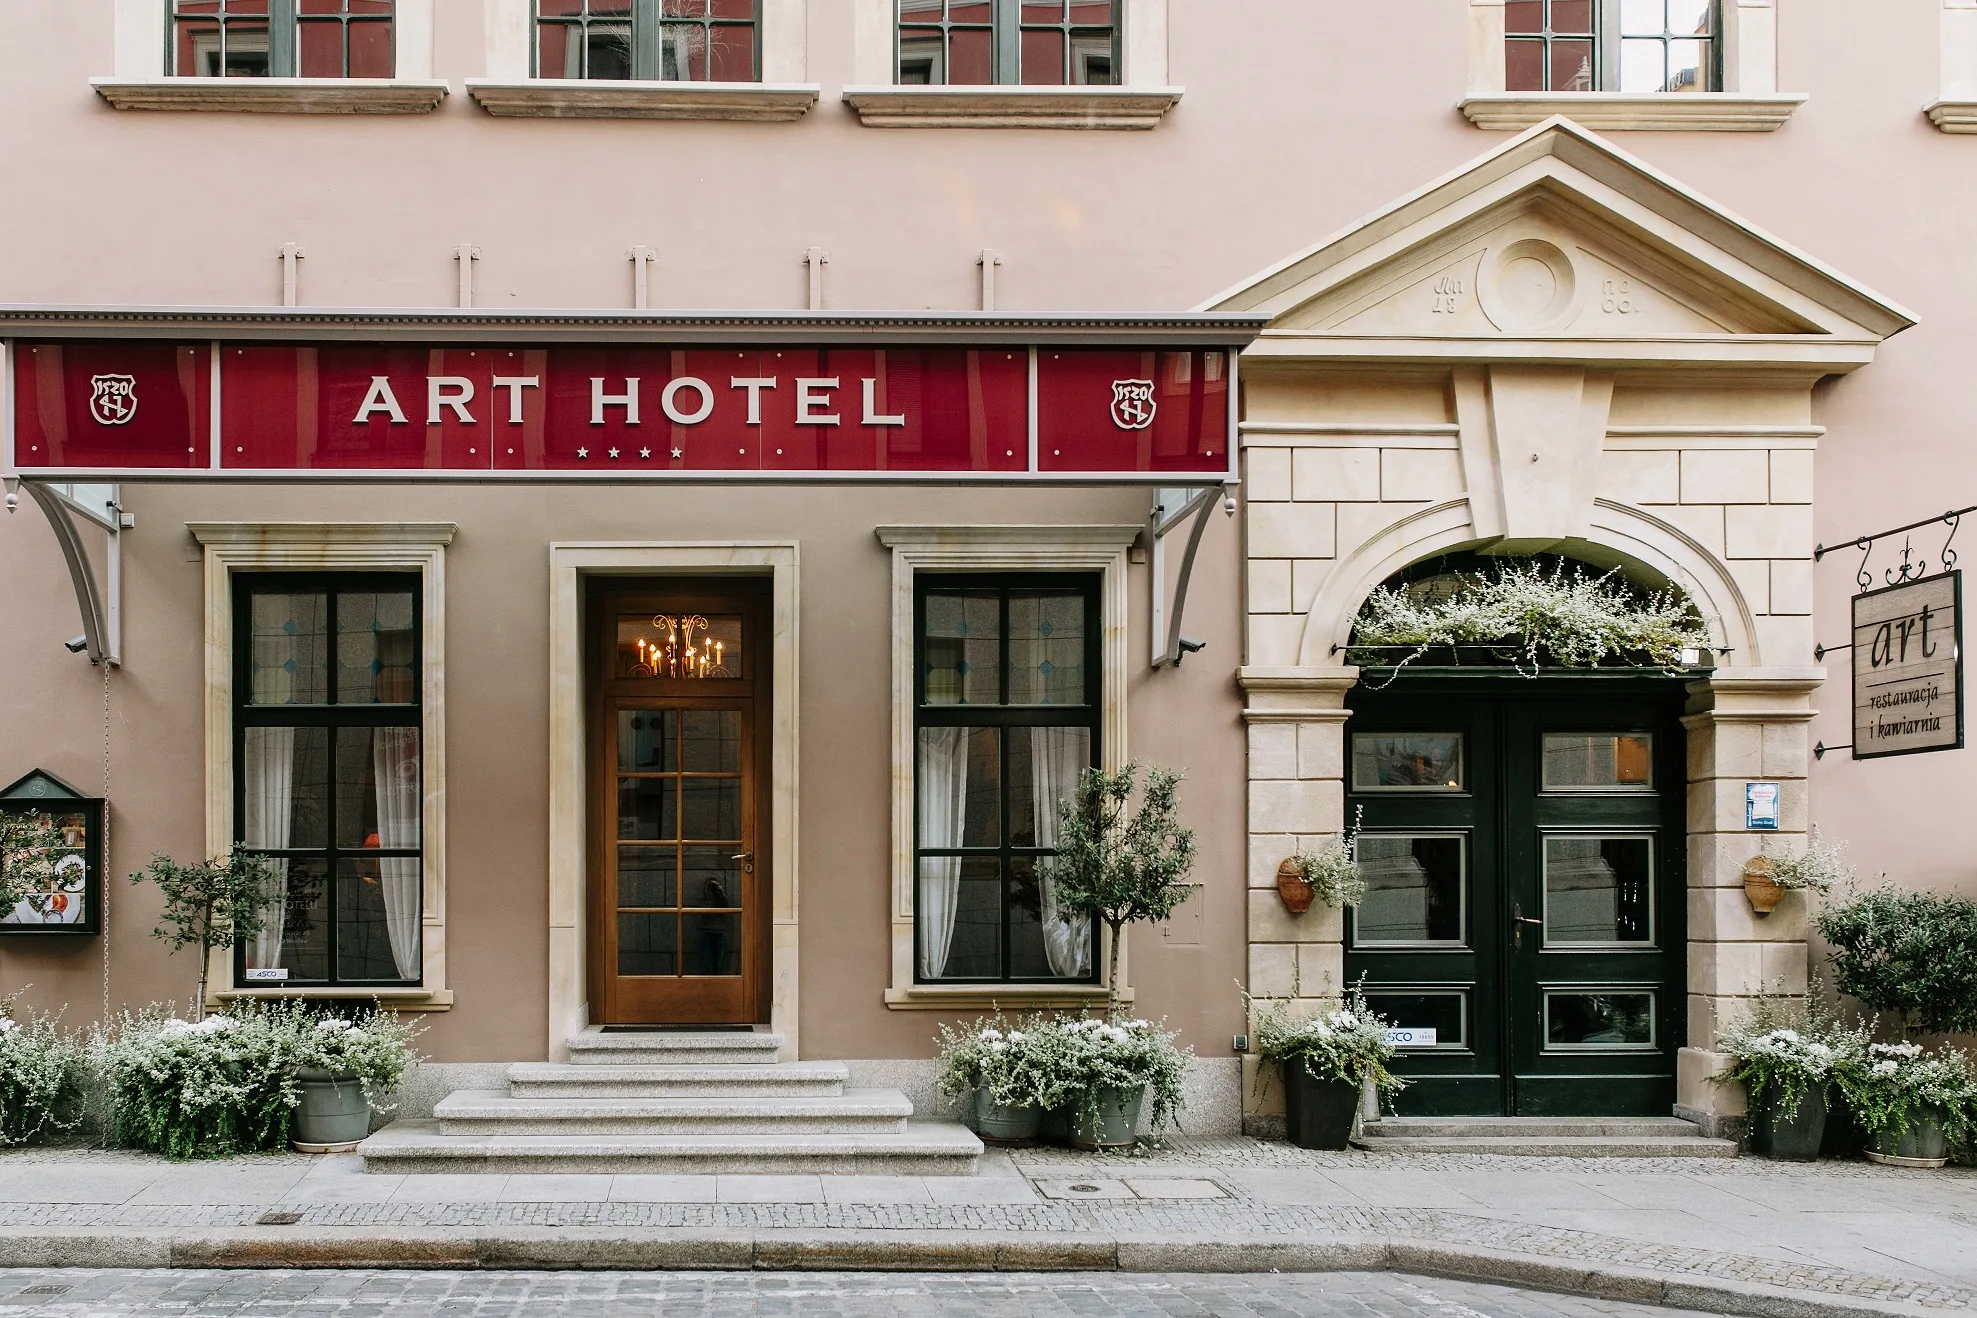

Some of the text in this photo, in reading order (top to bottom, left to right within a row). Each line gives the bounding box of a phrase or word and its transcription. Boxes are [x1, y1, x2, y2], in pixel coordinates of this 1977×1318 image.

[97, 381, 129, 395] 1520
[1117, 386, 1148, 400] 1520
[352, 375, 905, 427] ART HOTEL
[1871, 604, 1936, 668] art
[1870, 682, 1939, 709] restauracja
[1870, 713, 1941, 740] i kawiarnia
[256, 970, 277, 978] ASCO
[1383, 1032, 1413, 1042] SCO
